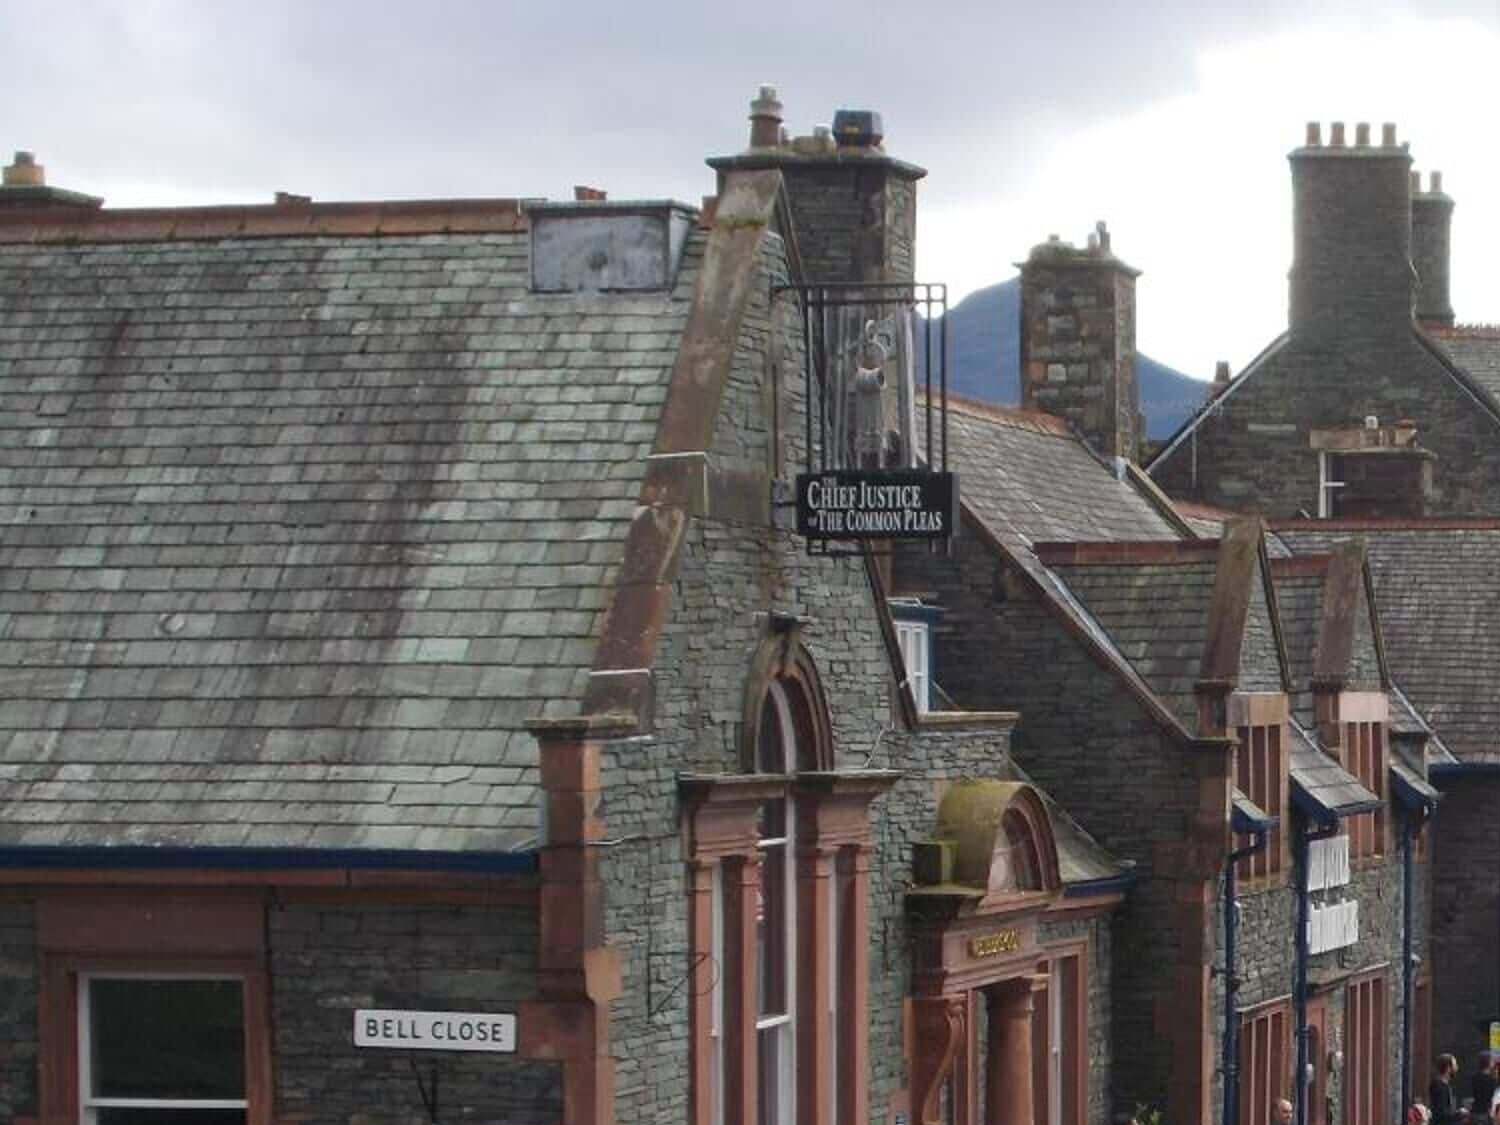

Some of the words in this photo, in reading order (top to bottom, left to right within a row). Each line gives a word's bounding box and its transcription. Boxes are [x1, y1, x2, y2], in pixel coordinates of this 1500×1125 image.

[807, 481, 857, 509] CHIEF
[858, 480, 922, 509] JUSTICE
[817, 510, 844, 531] THE
[846, 509, 900, 531] COMMON
[903, 509, 943, 531] PLEAS
[365, 1018, 422, 1040] BELL
[431, 1021, 503, 1043] CLOSE
